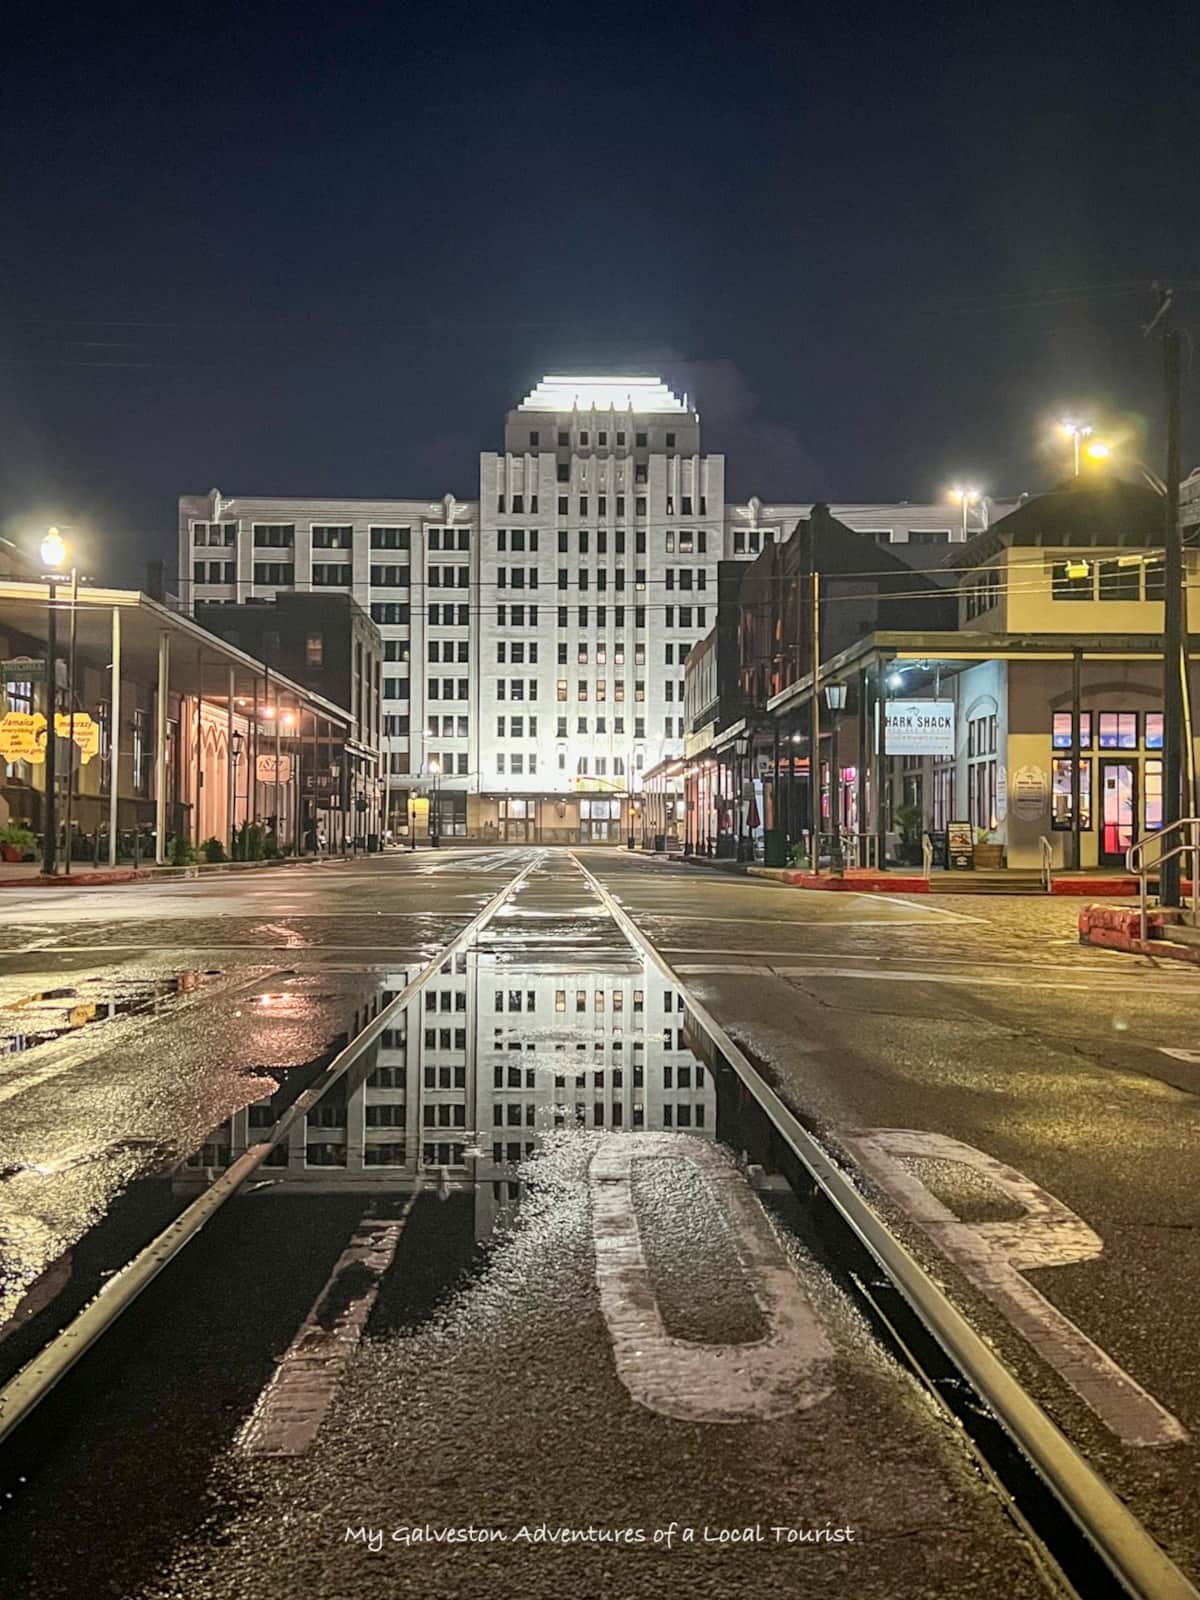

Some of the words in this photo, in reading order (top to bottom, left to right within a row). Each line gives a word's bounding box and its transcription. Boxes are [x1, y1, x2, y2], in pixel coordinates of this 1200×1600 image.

[3, 718, 34, 727] Jamaica
[885, 716, 913, 728] HARK
[916, 716, 952, 728] SHACK
